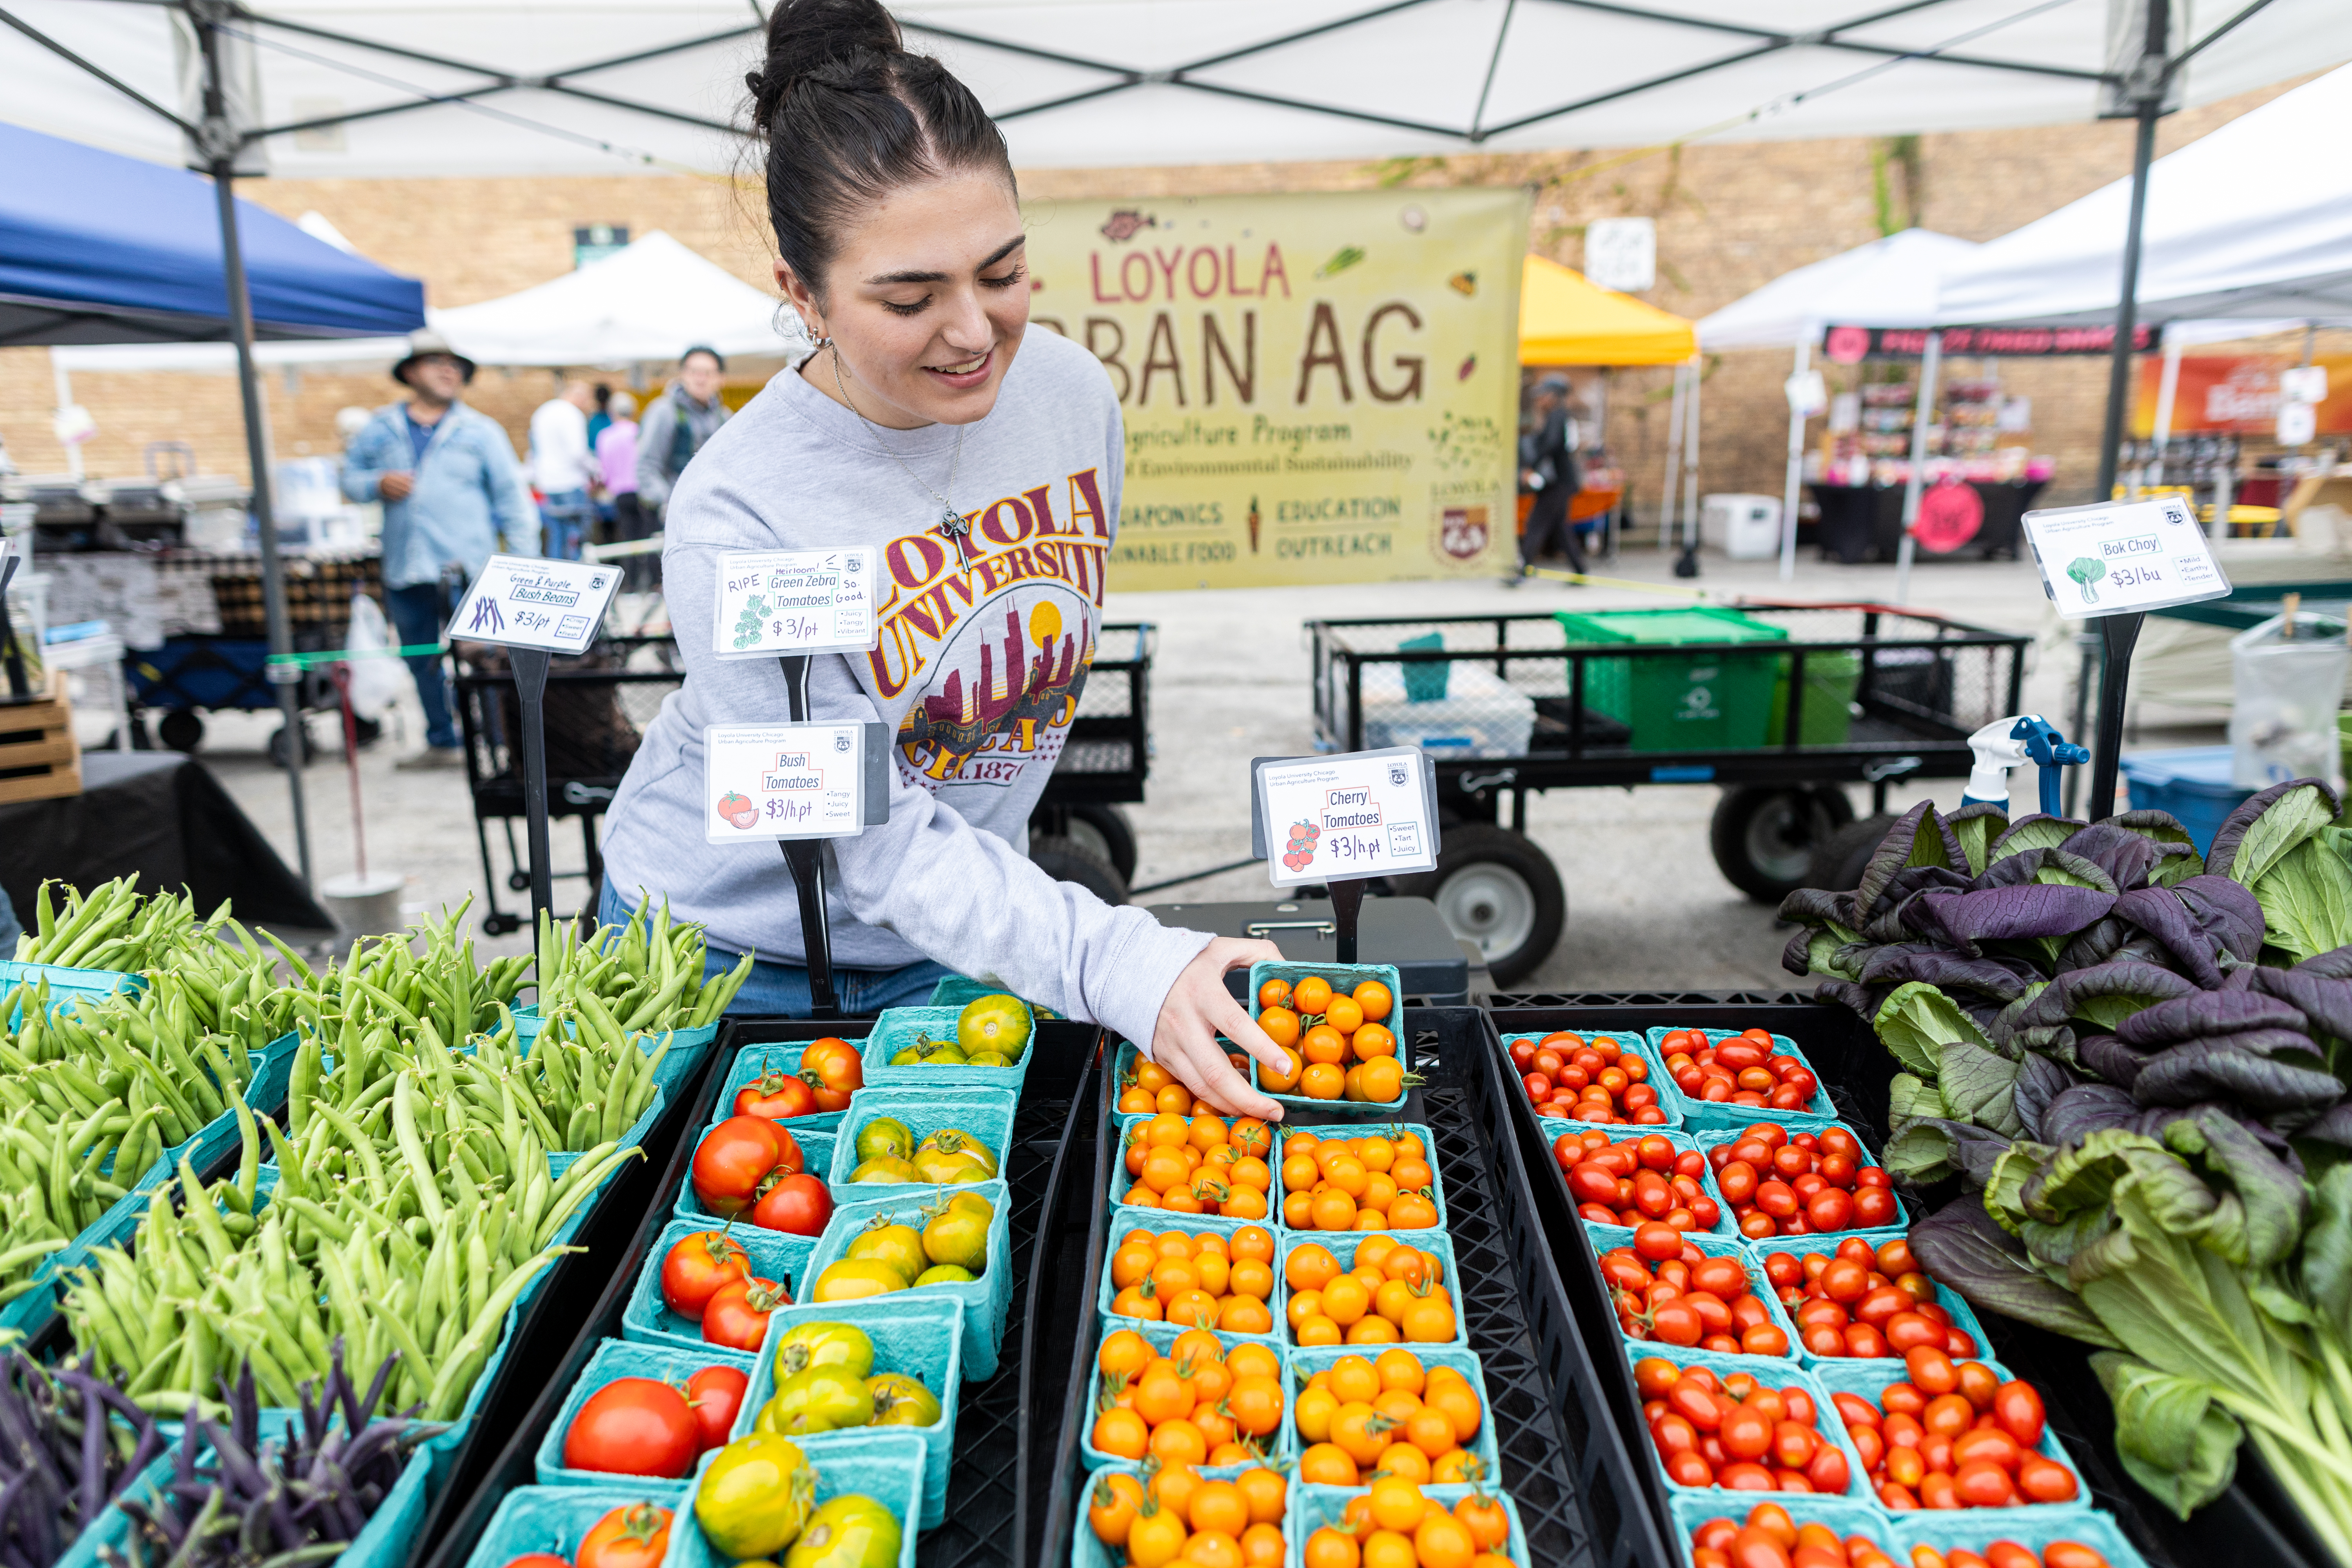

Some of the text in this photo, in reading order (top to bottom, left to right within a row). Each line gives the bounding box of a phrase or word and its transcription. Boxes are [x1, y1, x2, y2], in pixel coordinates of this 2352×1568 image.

[1089, 240, 1291, 305] LOYOLA
[1028, 300, 1425, 406] BAN AG
[1123, 413, 1352, 455] griculture Program
[1285, 449, 1413, 474] Sustainability
[1276, 495, 1402, 522] EDUCATION
[878, 467, 1109, 617] OYOLA
[1187, 540, 1237, 563] FOOD
[1276, 534, 1392, 560] OUTREACH
[2104, 539, 2156, 555] Bok Choy
[776, 563, 819, 575] Heirloom!
[2111, 567, 2162, 588] $3/bu
[510, 573, 571, 590] Green & Purple
[728, 573, 760, 593] RIPE
[771, 575, 836, 588] Green Zebra
[515, 588, 575, 604] Bush Beans
[777, 595, 830, 607] Tomatoes
[515, 611, 550, 631] $3/pt
[773, 617, 818, 641] $3/pt
[780, 753, 805, 767] Bush
[766, 776, 819, 789] Tomatoes
[1330, 791, 1367, 805] Cherry
[1324, 813, 1379, 828] Tomatoes
